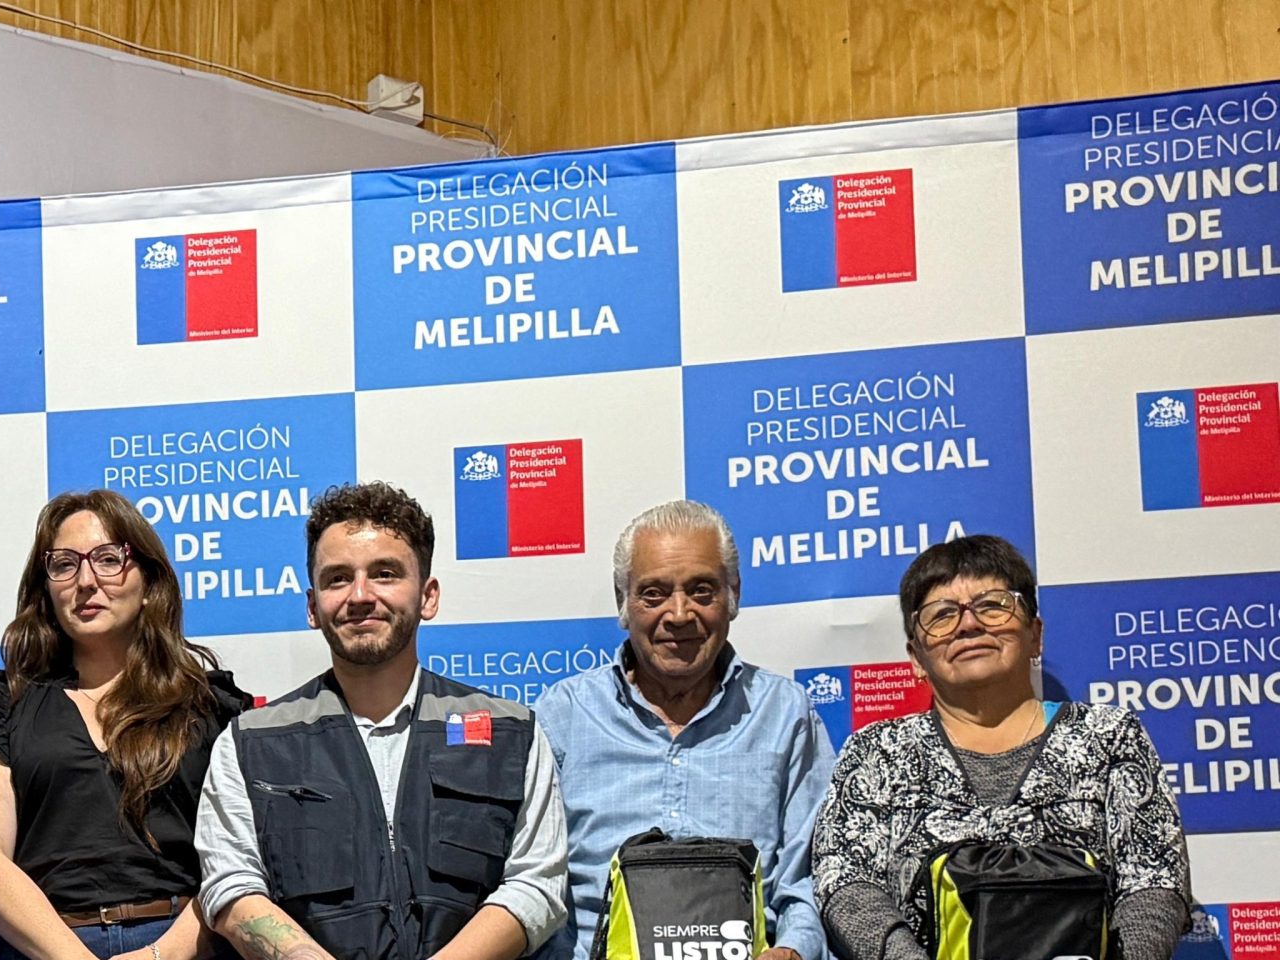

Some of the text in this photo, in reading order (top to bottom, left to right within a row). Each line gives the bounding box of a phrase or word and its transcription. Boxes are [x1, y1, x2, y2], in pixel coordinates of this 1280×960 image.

[1091, 92, 1278, 139] DELEGACIÓ
[1084, 128, 1280, 171] PRESIDENCI
[417, 160, 609, 205] DELEGACIÓN
[837, 176, 892, 188] Delegación
[837, 186, 896, 199] Presidencial
[1064, 161, 1278, 213] PROVINCI
[411, 194, 618, 235] PRESIDENCIAL
[838, 198, 886, 210] Provincial
[188, 236, 237, 246] Delegación
[1167, 208, 1223, 243] DE
[188, 246, 241, 257] Presidencial
[188, 257, 232, 267] Provincial
[393, 225, 639, 275] PROVINCIAL
[484, 273, 536, 306] DE
[414, 305, 621, 350] MELIPILLA
[753, 371, 955, 413] DELEGACIÓN
[1198, 390, 1256, 402] Delegación
[1199, 401, 1261, 414] Presidencial
[747, 405, 966, 446] PRESIDENCIAL
[1200, 414, 1251, 426] Provincial
[110, 423, 290, 459] DELEGACIÓN
[510, 446, 562, 457] Delegación
[104, 456, 300, 489] PRESIDENCIAL
[510, 456, 566, 468] Presidencial
[510, 468, 556, 479] Provincial
[728, 437, 989, 488] PROVINCIAL
[135, 487, 313, 525] OVINCIAL
[826, 486, 881, 520] DE
[174, 531, 222, 562] DE
[180, 565, 302, 601] IPILLA
[1115, 603, 1280, 636] DELEGACI
[854, 667, 911, 679] Delegación
[854, 679, 916, 691] Presidencial
[855, 691, 905, 703] Provincial
[1195, 716, 1253, 751] DE
[1161, 758, 1280, 794] ELIPIL
[1232, 907, 1280, 919] Delegaci
[1233, 920, 1280, 930] Presiden
[653, 925, 720, 938] SIEMPRE
